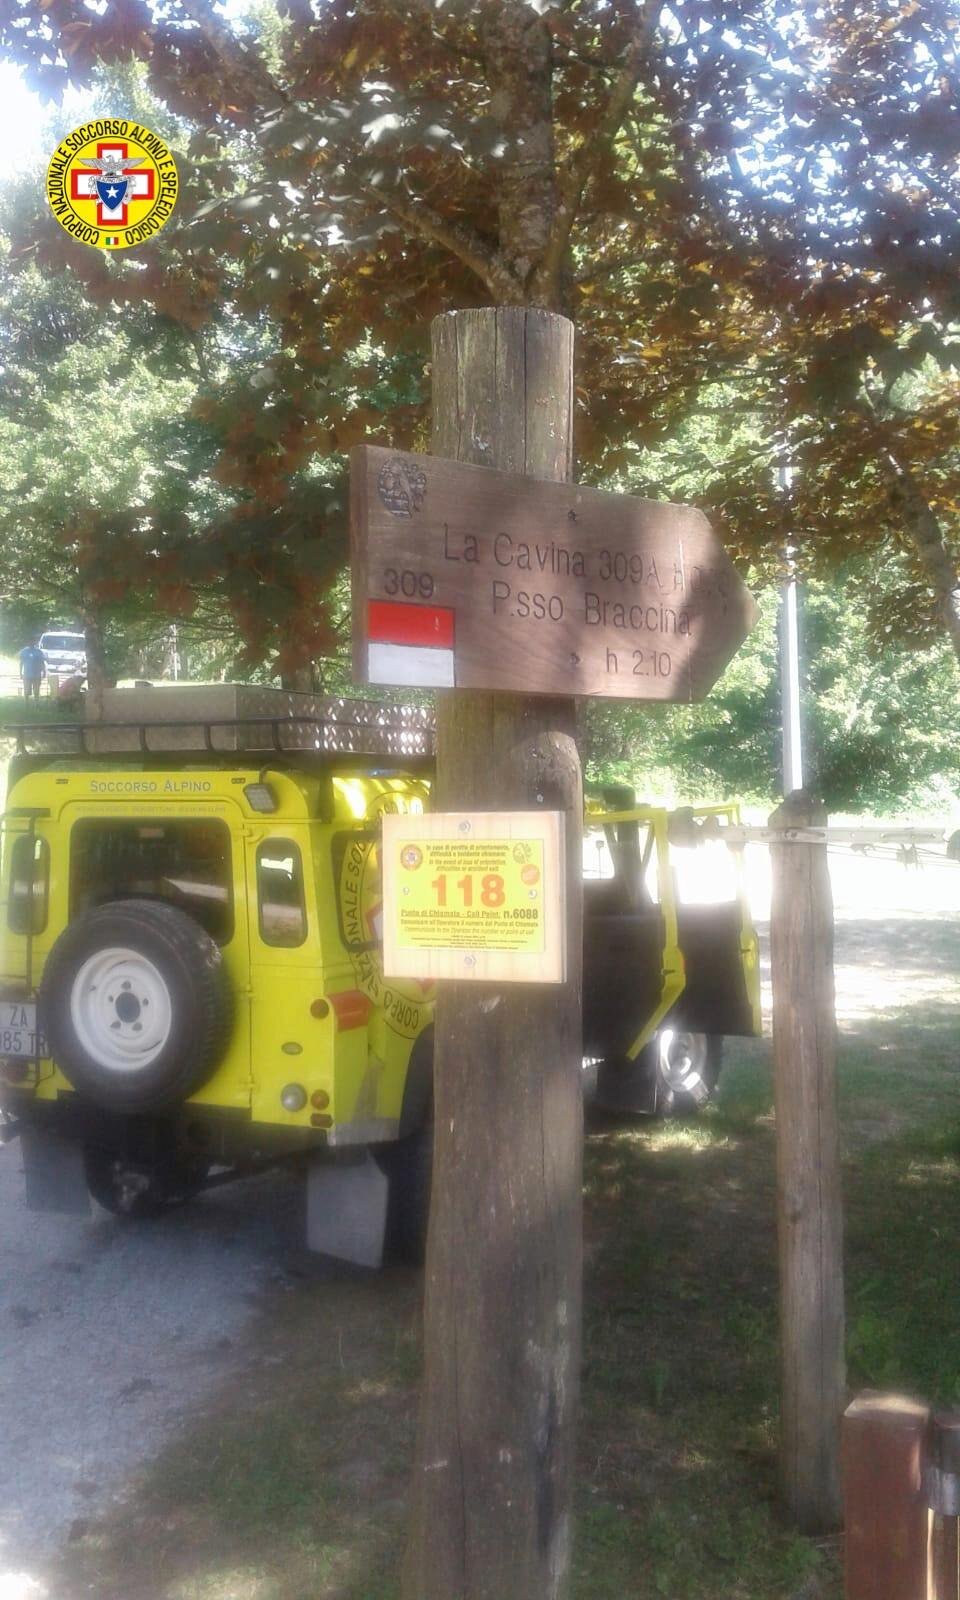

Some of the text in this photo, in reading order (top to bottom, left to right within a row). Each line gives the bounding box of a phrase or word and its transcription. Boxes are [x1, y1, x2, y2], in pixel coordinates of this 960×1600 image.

[443, 522, 480, 564] La
[493, 531, 587, 577] Cavina
[599, 550, 664, 589] 309A
[384, 567, 434, 599] 309
[491, 580, 693, 637] P.sso Braccina
[606, 647, 672, 677] h 2.10
[431, 873, 506, 909] 118
[503, 908, 539, 920] n.6088
[343, 880, 380, 999] NAZONALE
[9, 1004, 29, 1028] ZA
[383, 990, 419, 1031] CORPO
[0, 1030, 22, 1053] 85
